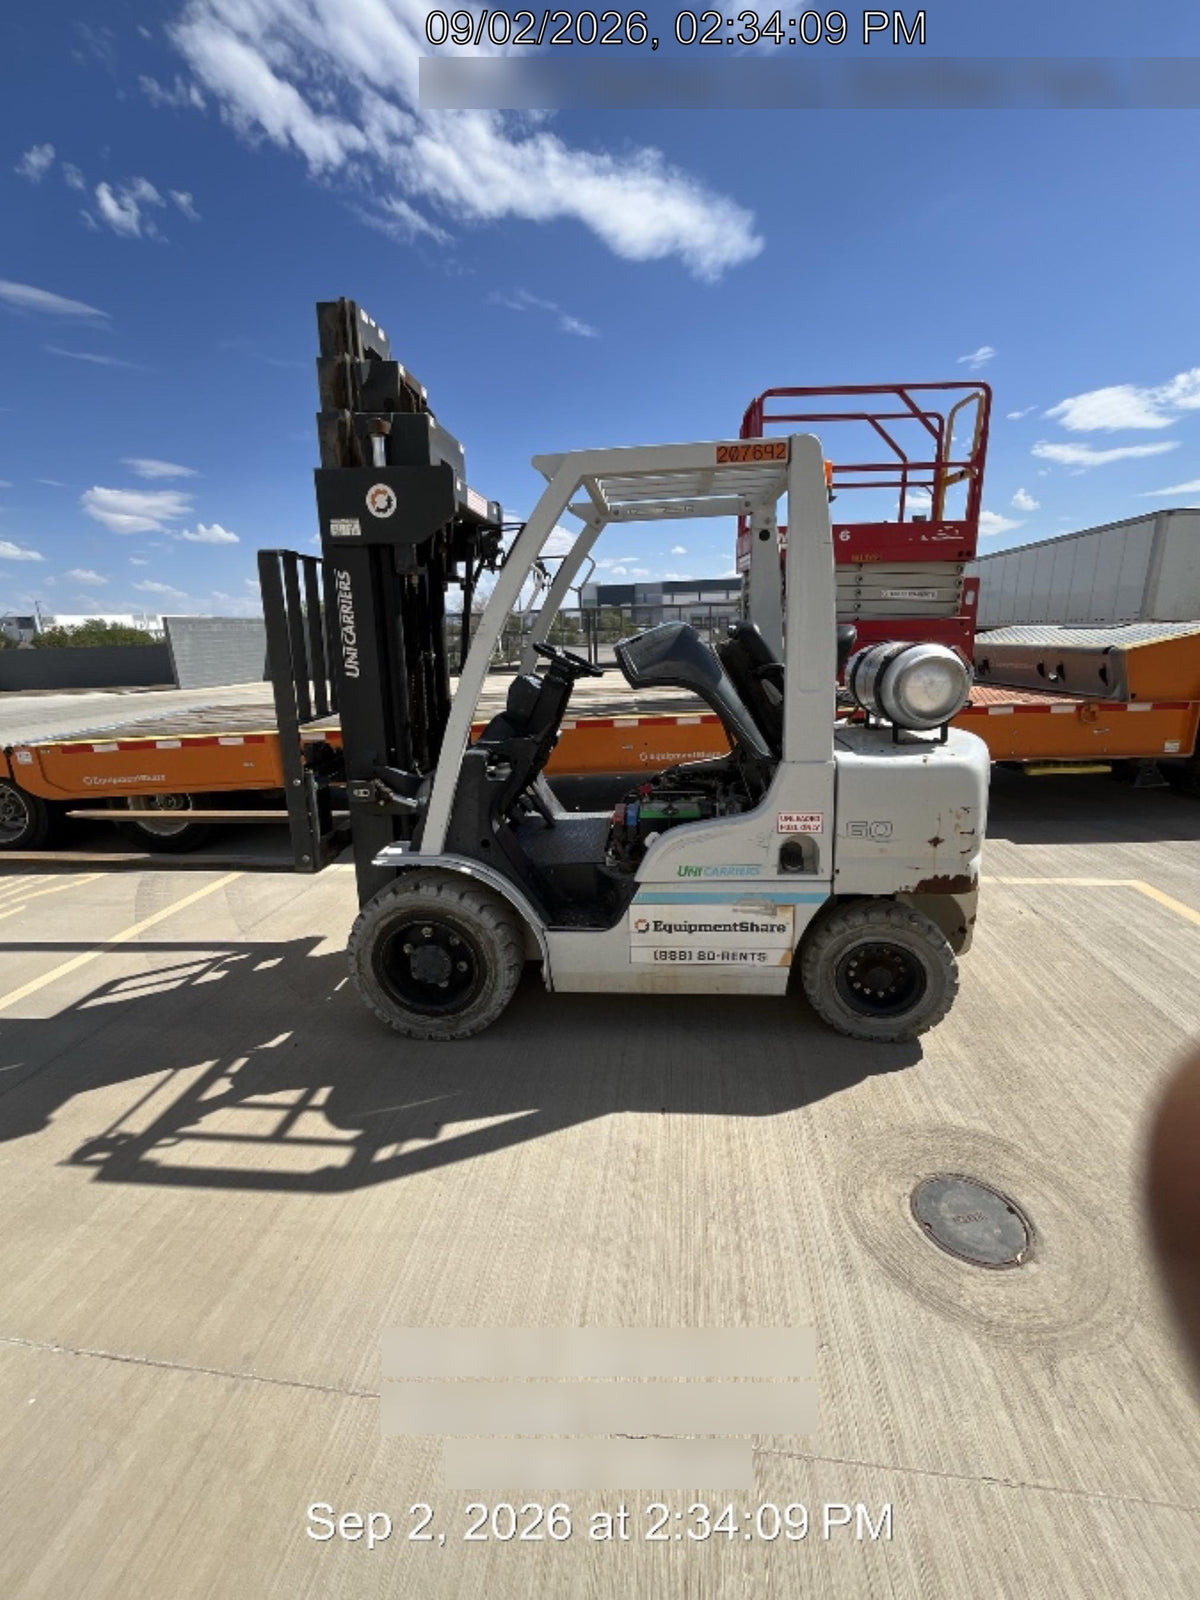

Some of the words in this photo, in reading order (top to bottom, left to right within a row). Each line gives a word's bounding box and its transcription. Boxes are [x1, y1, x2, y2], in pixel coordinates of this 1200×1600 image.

[717, 441, 787, 464] 207692
[333, 568, 360, 679] UNICARRIERS
[652, 920, 787, 934] EquipmentShare
[697, 950, 768, 963] 80-RENTS
